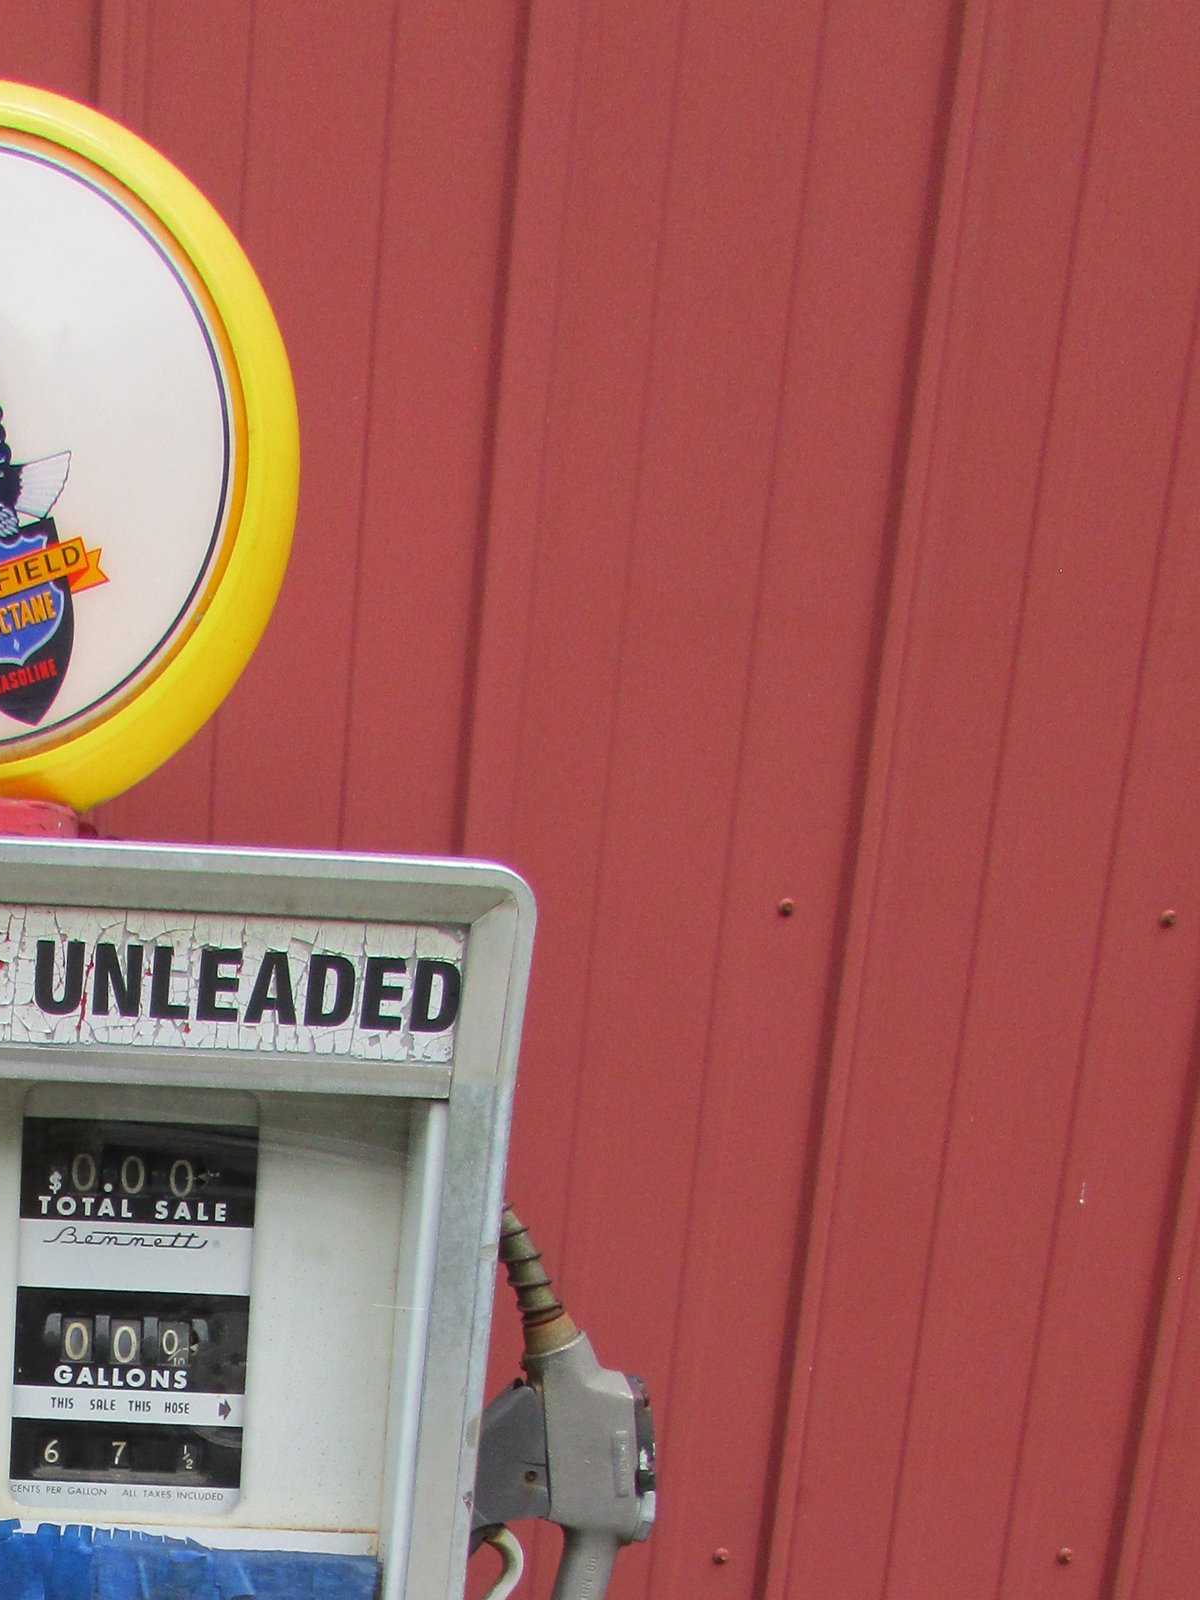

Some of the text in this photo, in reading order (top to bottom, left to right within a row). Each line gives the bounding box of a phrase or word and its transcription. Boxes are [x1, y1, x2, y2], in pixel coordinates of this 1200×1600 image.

[33, 939, 462, 1033] UNLEADED
[38, 1195, 227, 1222] TOTAL SALE
[53, 1365, 188, 1389] GALLONS
[51, 1396, 190, 1414] THIS SALE THIS HOSE
[10, 1484, 224, 1501] CENTS PER GALLON ALL TAXES INCLUDED
